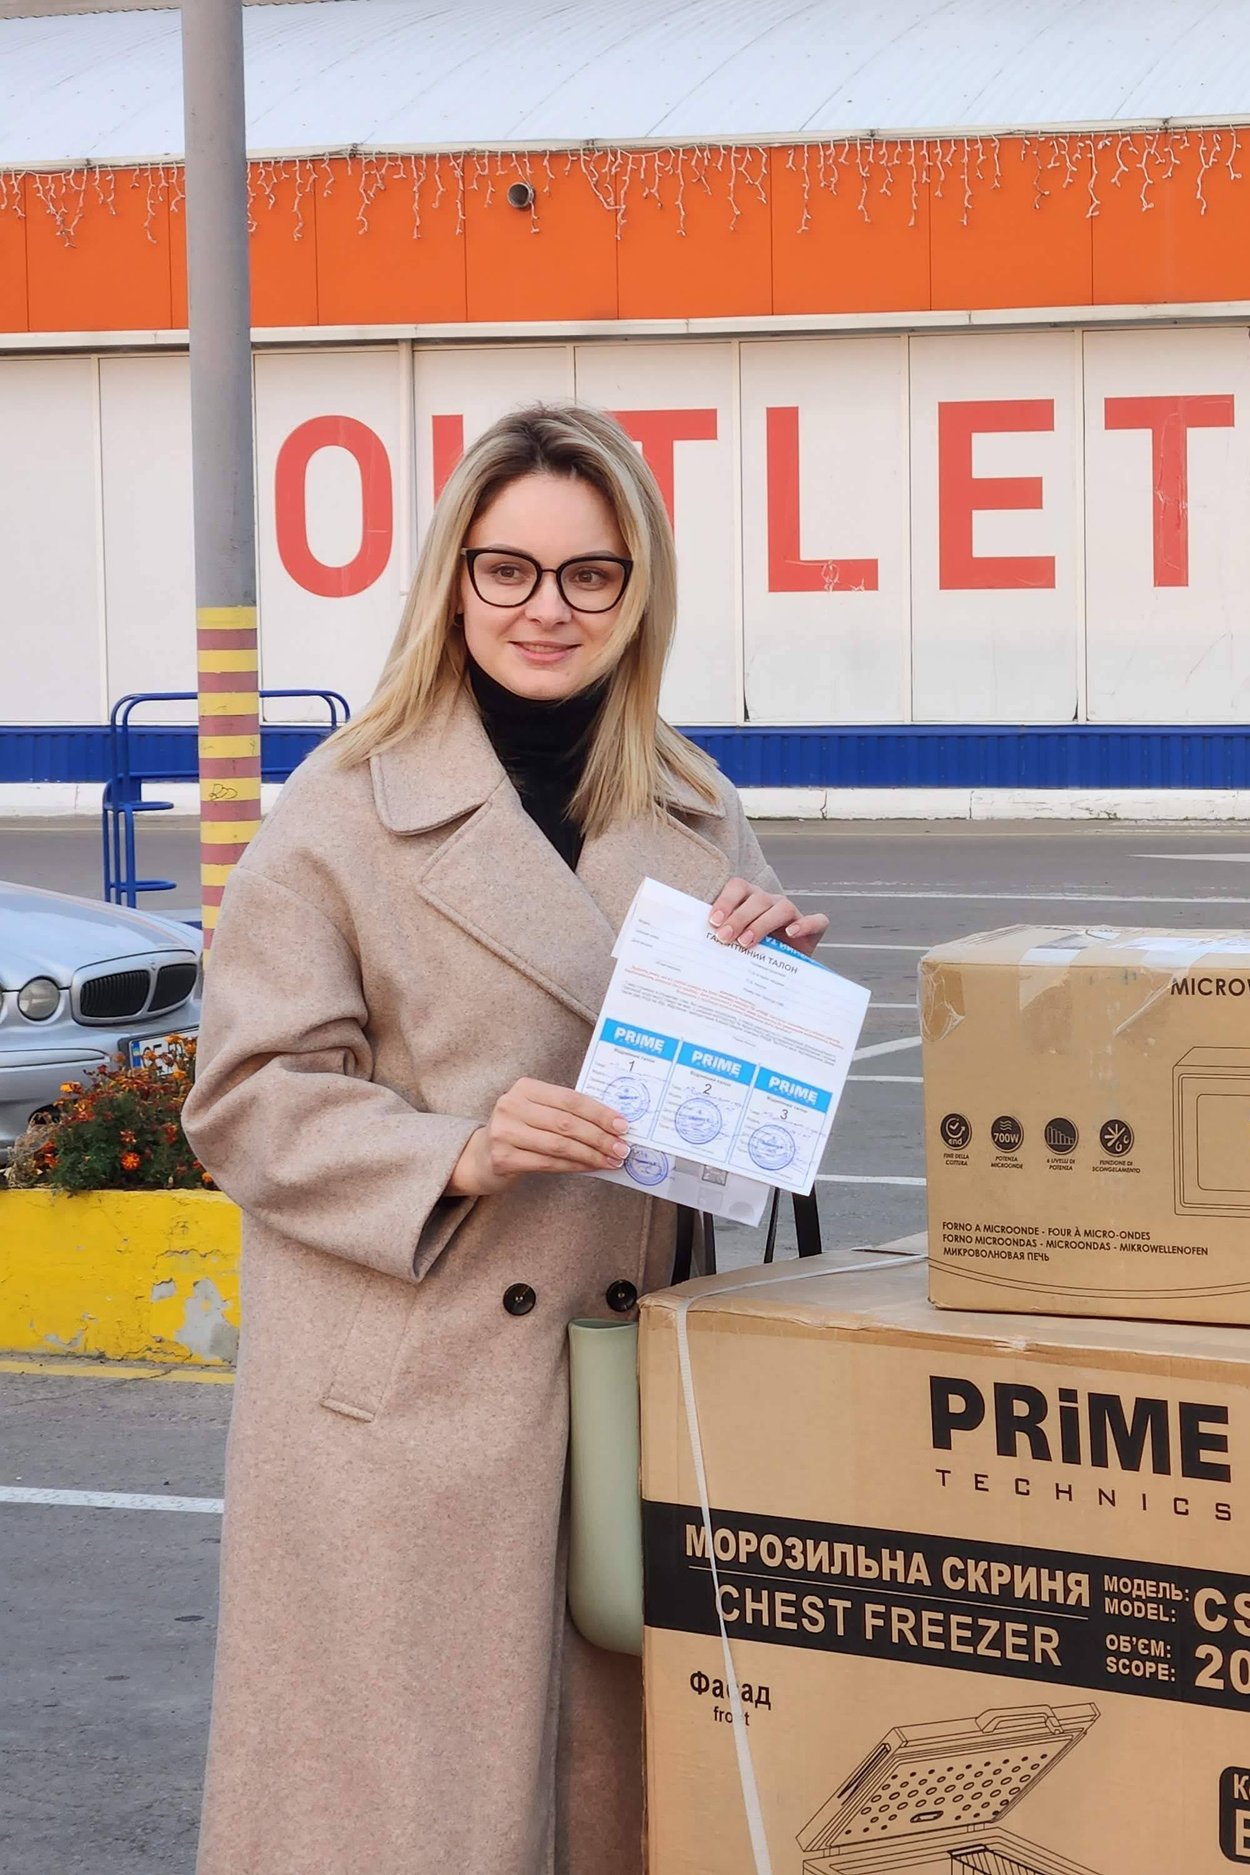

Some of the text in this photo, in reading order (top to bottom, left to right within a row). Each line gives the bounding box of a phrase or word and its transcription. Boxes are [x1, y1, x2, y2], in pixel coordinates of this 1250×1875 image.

[274, 395, 1235, 598] OTLET
[768, 957, 799, 975] ТАЛОН
[628, 1060, 635, 1072] 1
[703, 1083, 712, 1095] 2
[780, 1109, 789, 1120] 3
[993, 1132, 1019, 1143] 700W
[942, 1221, 972, 1232] FORNO
[974, 1224, 982, 1232] A
[982, 1224, 1039, 1236] MICROONDE
[1047, 1227, 1072, 1237] FOUR
[1074, 1226, 1081, 1237] À
[1083, 1229, 1151, 1240] MICRO-ONDES
[942, 1233, 973, 1244] FORNO
[974, 1236, 1037, 1248] MICROONDAS
[1045, 1240, 1111, 1251] MICROONDAS
[1119, 1243, 1208, 1256] MIKROWELLENOFEN
[943, 1247, 1050, 1261] МИКРОВОЛНОВАЯ ПЕЧЬ
[935, 1468, 1232, 1521] TECHNICS
[685, 1523, 1091, 1608] МОРОЗИЛЬНА СКРИНЯ
[1104, 1574, 1190, 1603] МОДЕЛЬ:
[1104, 1597, 1177, 1623] MODEL:
[716, 1583, 1063, 1667] CHEST FREEZER
[1105, 1656, 1177, 1682] SCOPE:
[689, 1671, 772, 1711] Фаад
[713, 1705, 750, 1727] frot
